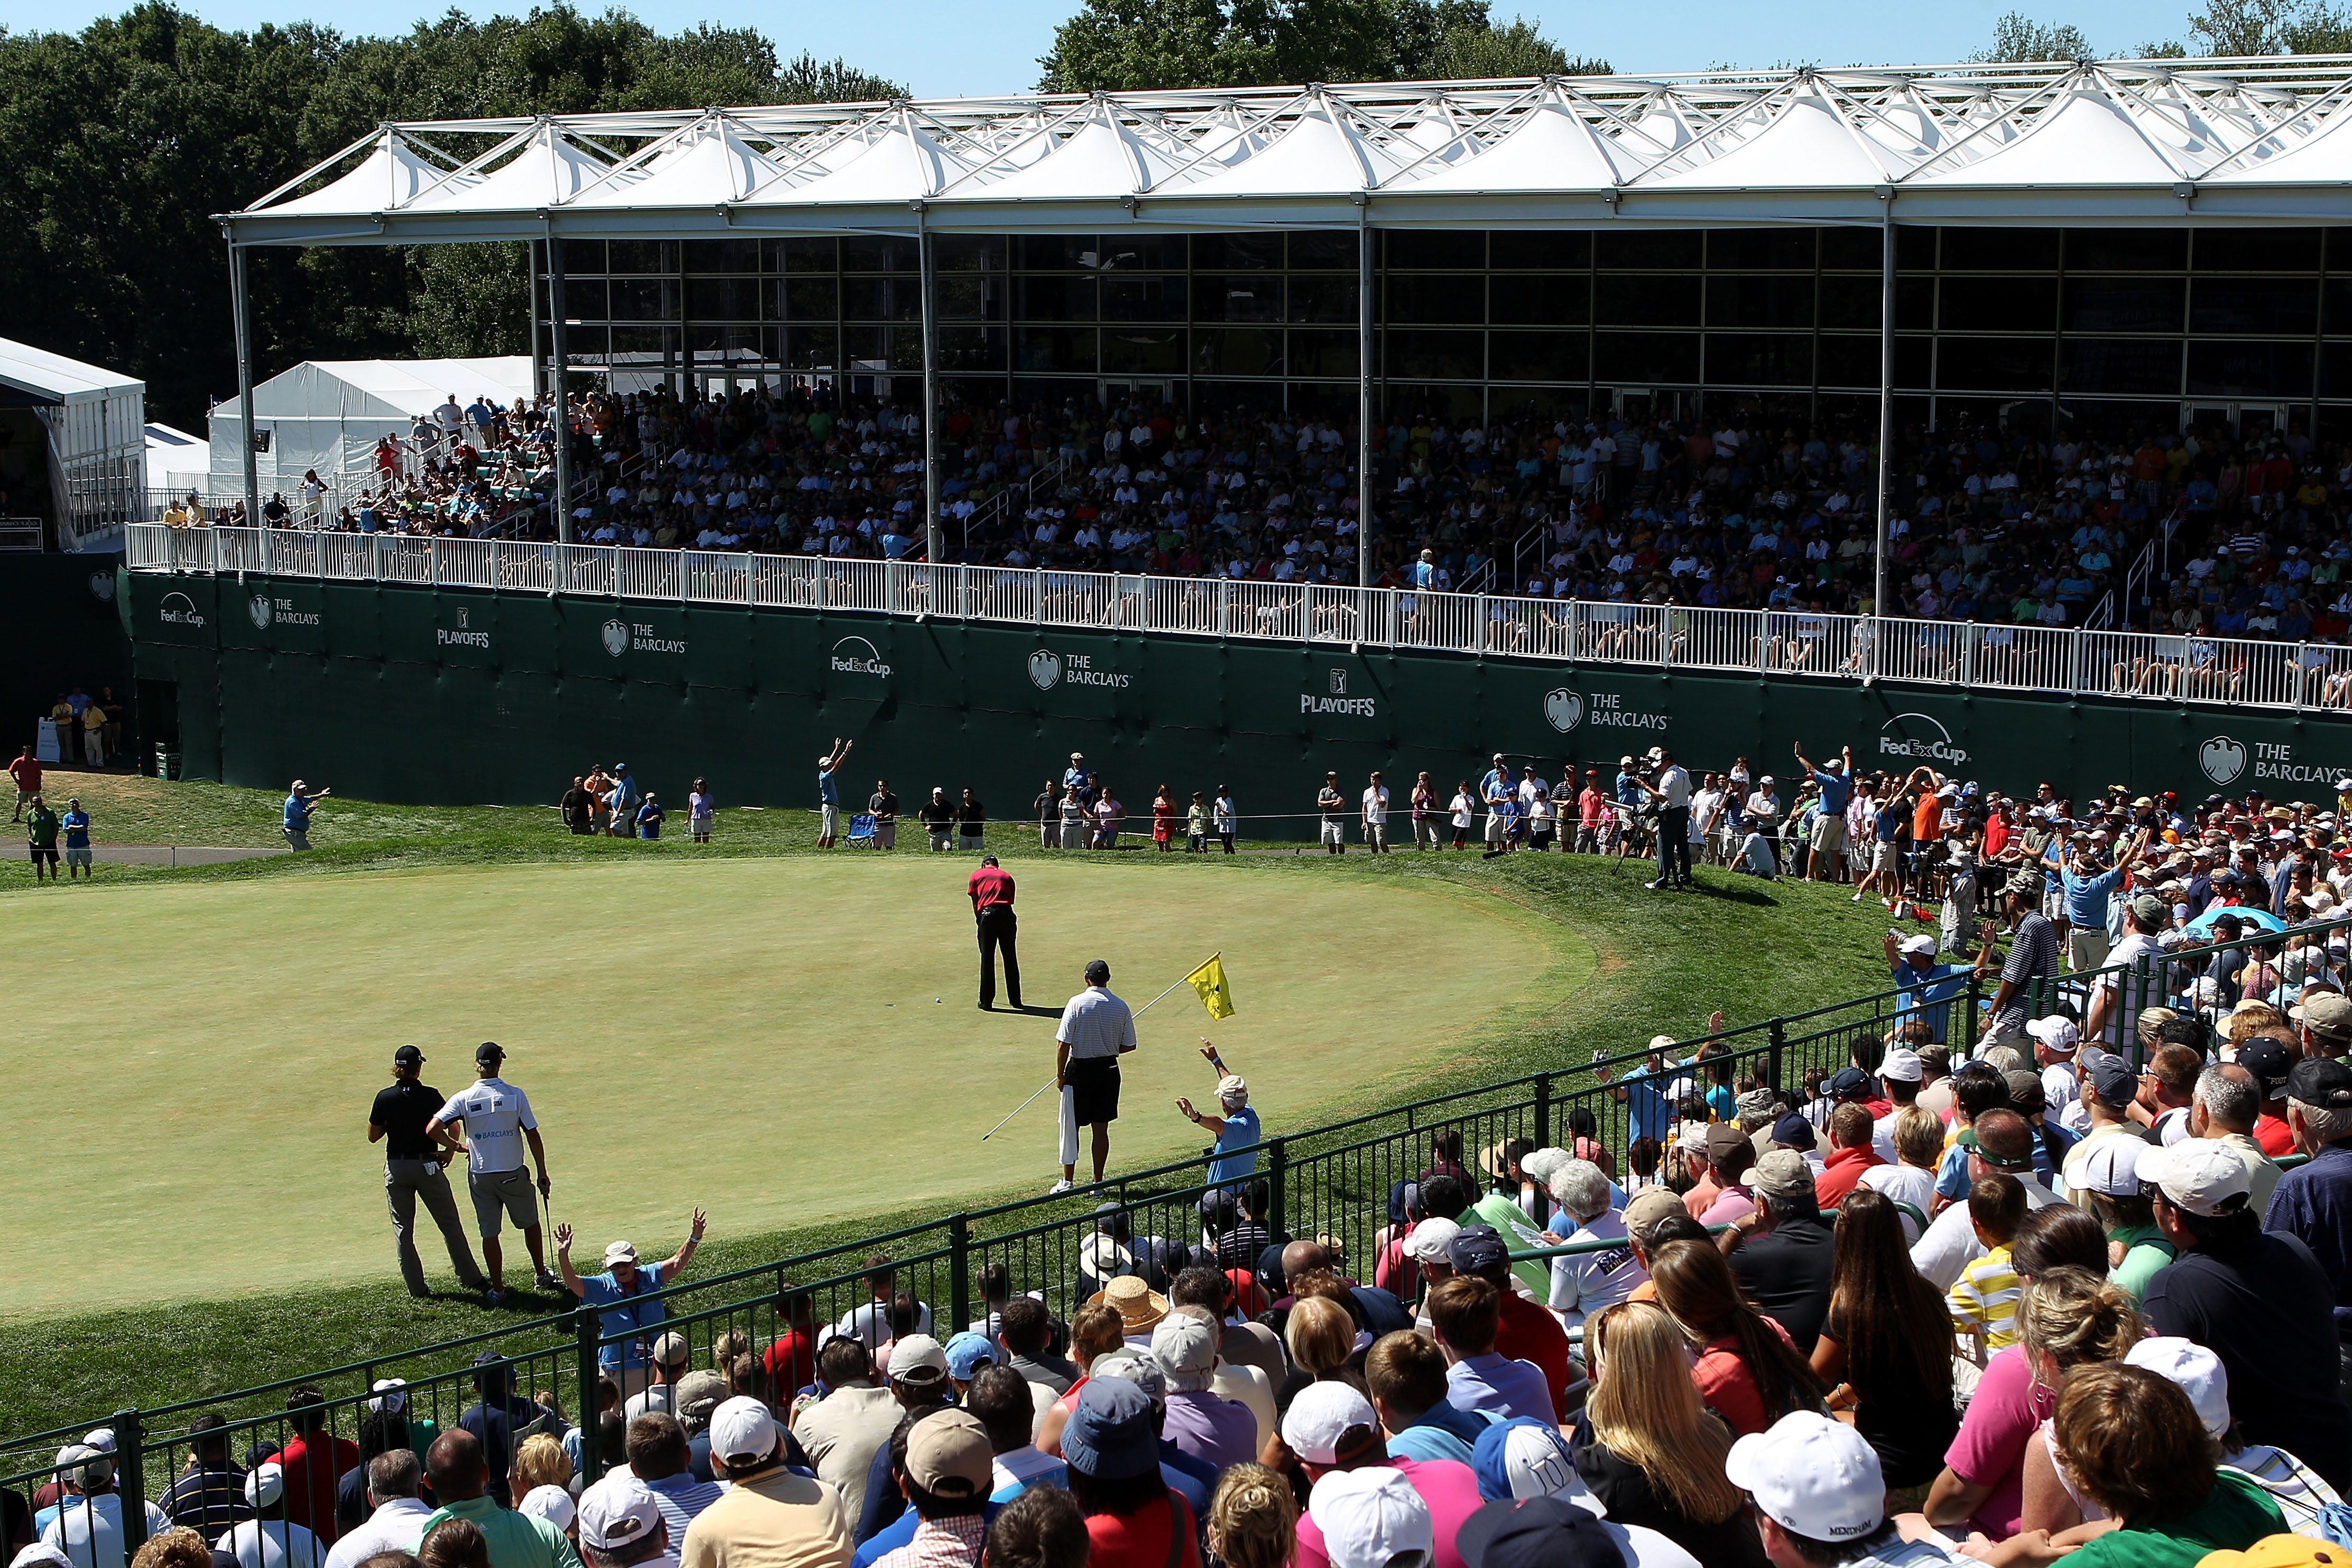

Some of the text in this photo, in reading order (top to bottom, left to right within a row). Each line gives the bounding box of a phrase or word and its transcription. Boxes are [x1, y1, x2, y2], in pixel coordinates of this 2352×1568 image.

[274, 598, 292, 610] THE
[275, 611, 319, 625] BARCLAYS
[437, 628, 489, 648] PLAYOFFS
[633, 624, 653, 636] THE
[634, 638, 686, 653] BARCLAYS
[831, 656, 891, 679] FedExCup
[1066, 654, 1091, 669] THE
[1066, 670, 1129, 688] BARCLAYS
[1301, 694, 1375, 717] PLAYOFFS
[1590, 693, 1621, 709] THE
[1590, 710, 1668, 730] BARCLAYS
[1879, 737, 1967, 766] FedExCup
[2254, 742, 2291, 760] THE
[2254, 762, 2347, 784] BARCLAYS
[482, 1129, 514, 1139] BARCLAYS
[1829, 1519, 1873, 1536] MENDHAM
